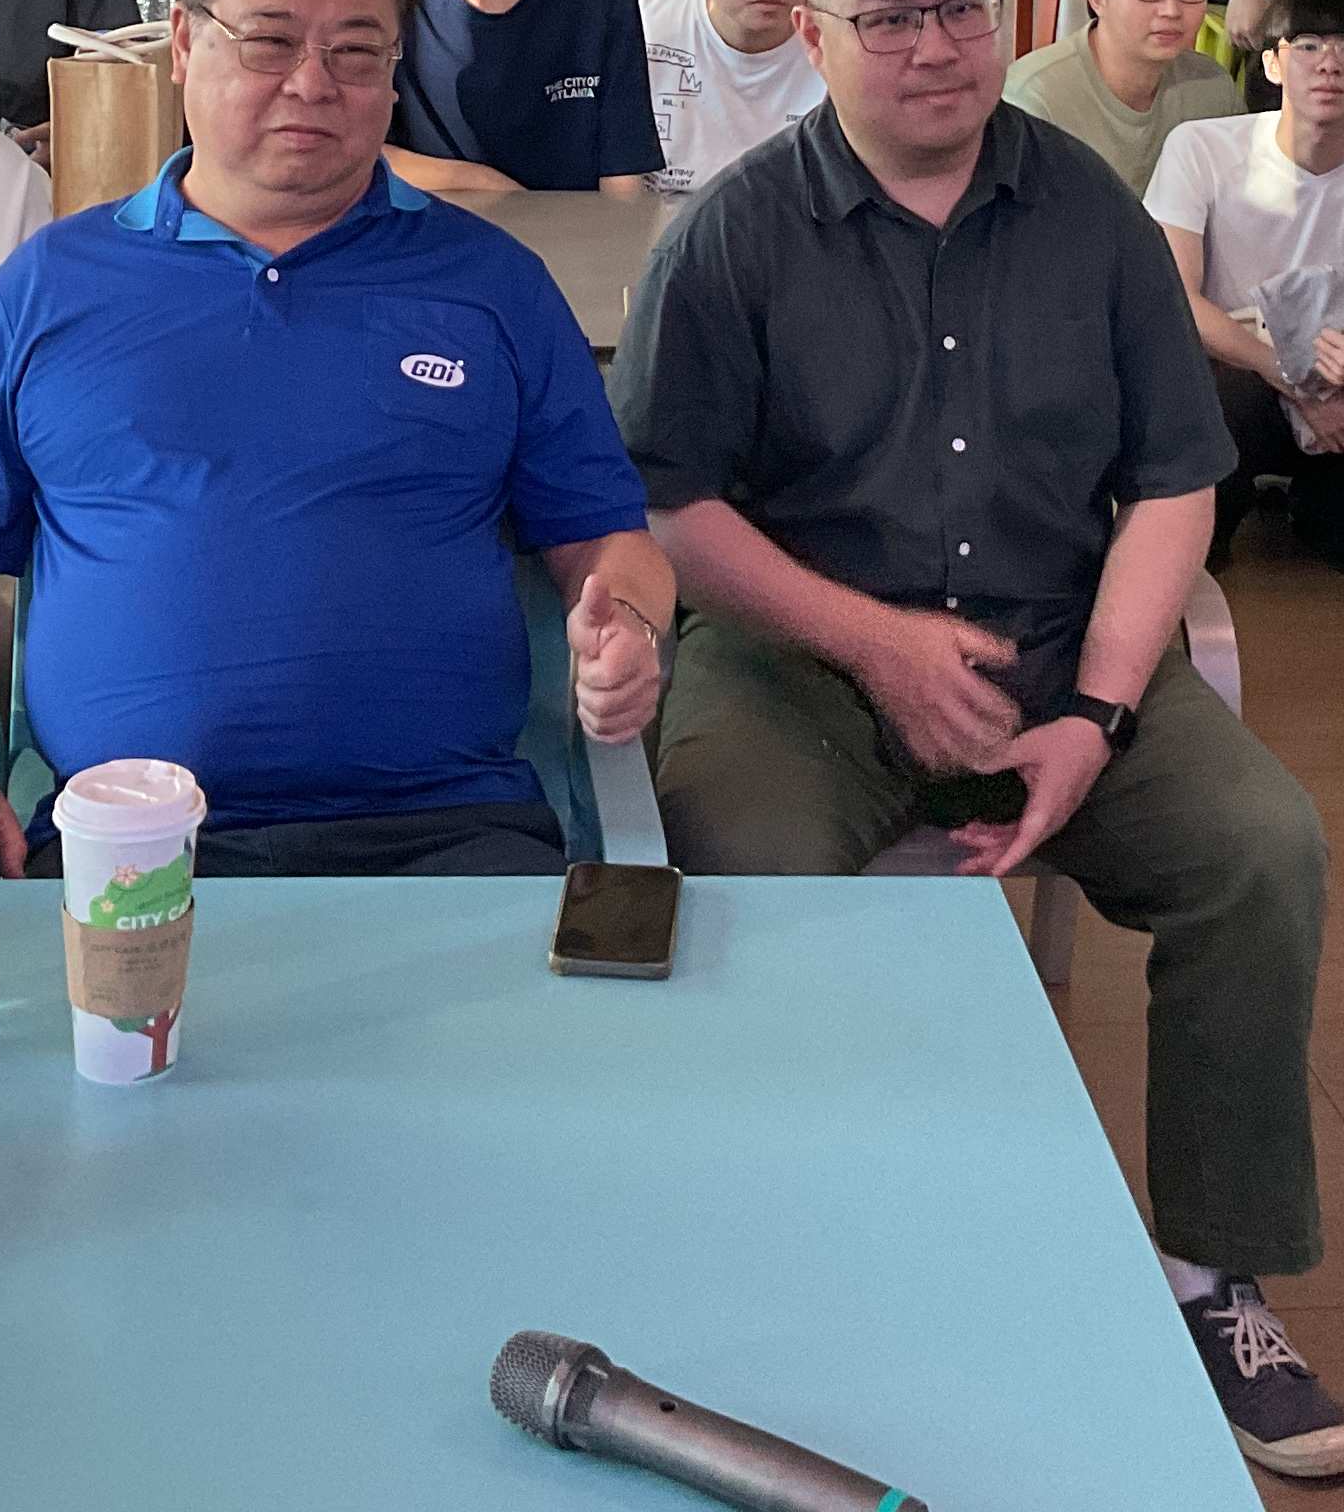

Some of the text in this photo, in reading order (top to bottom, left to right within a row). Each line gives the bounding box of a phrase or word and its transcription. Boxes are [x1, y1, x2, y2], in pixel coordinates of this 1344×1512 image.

[544, 76, 600, 95] THE CITY OF
[550, 87, 595, 103] ATLANTA
[116, 911, 163, 930] CITY
[168, 896, 192, 921] CA
